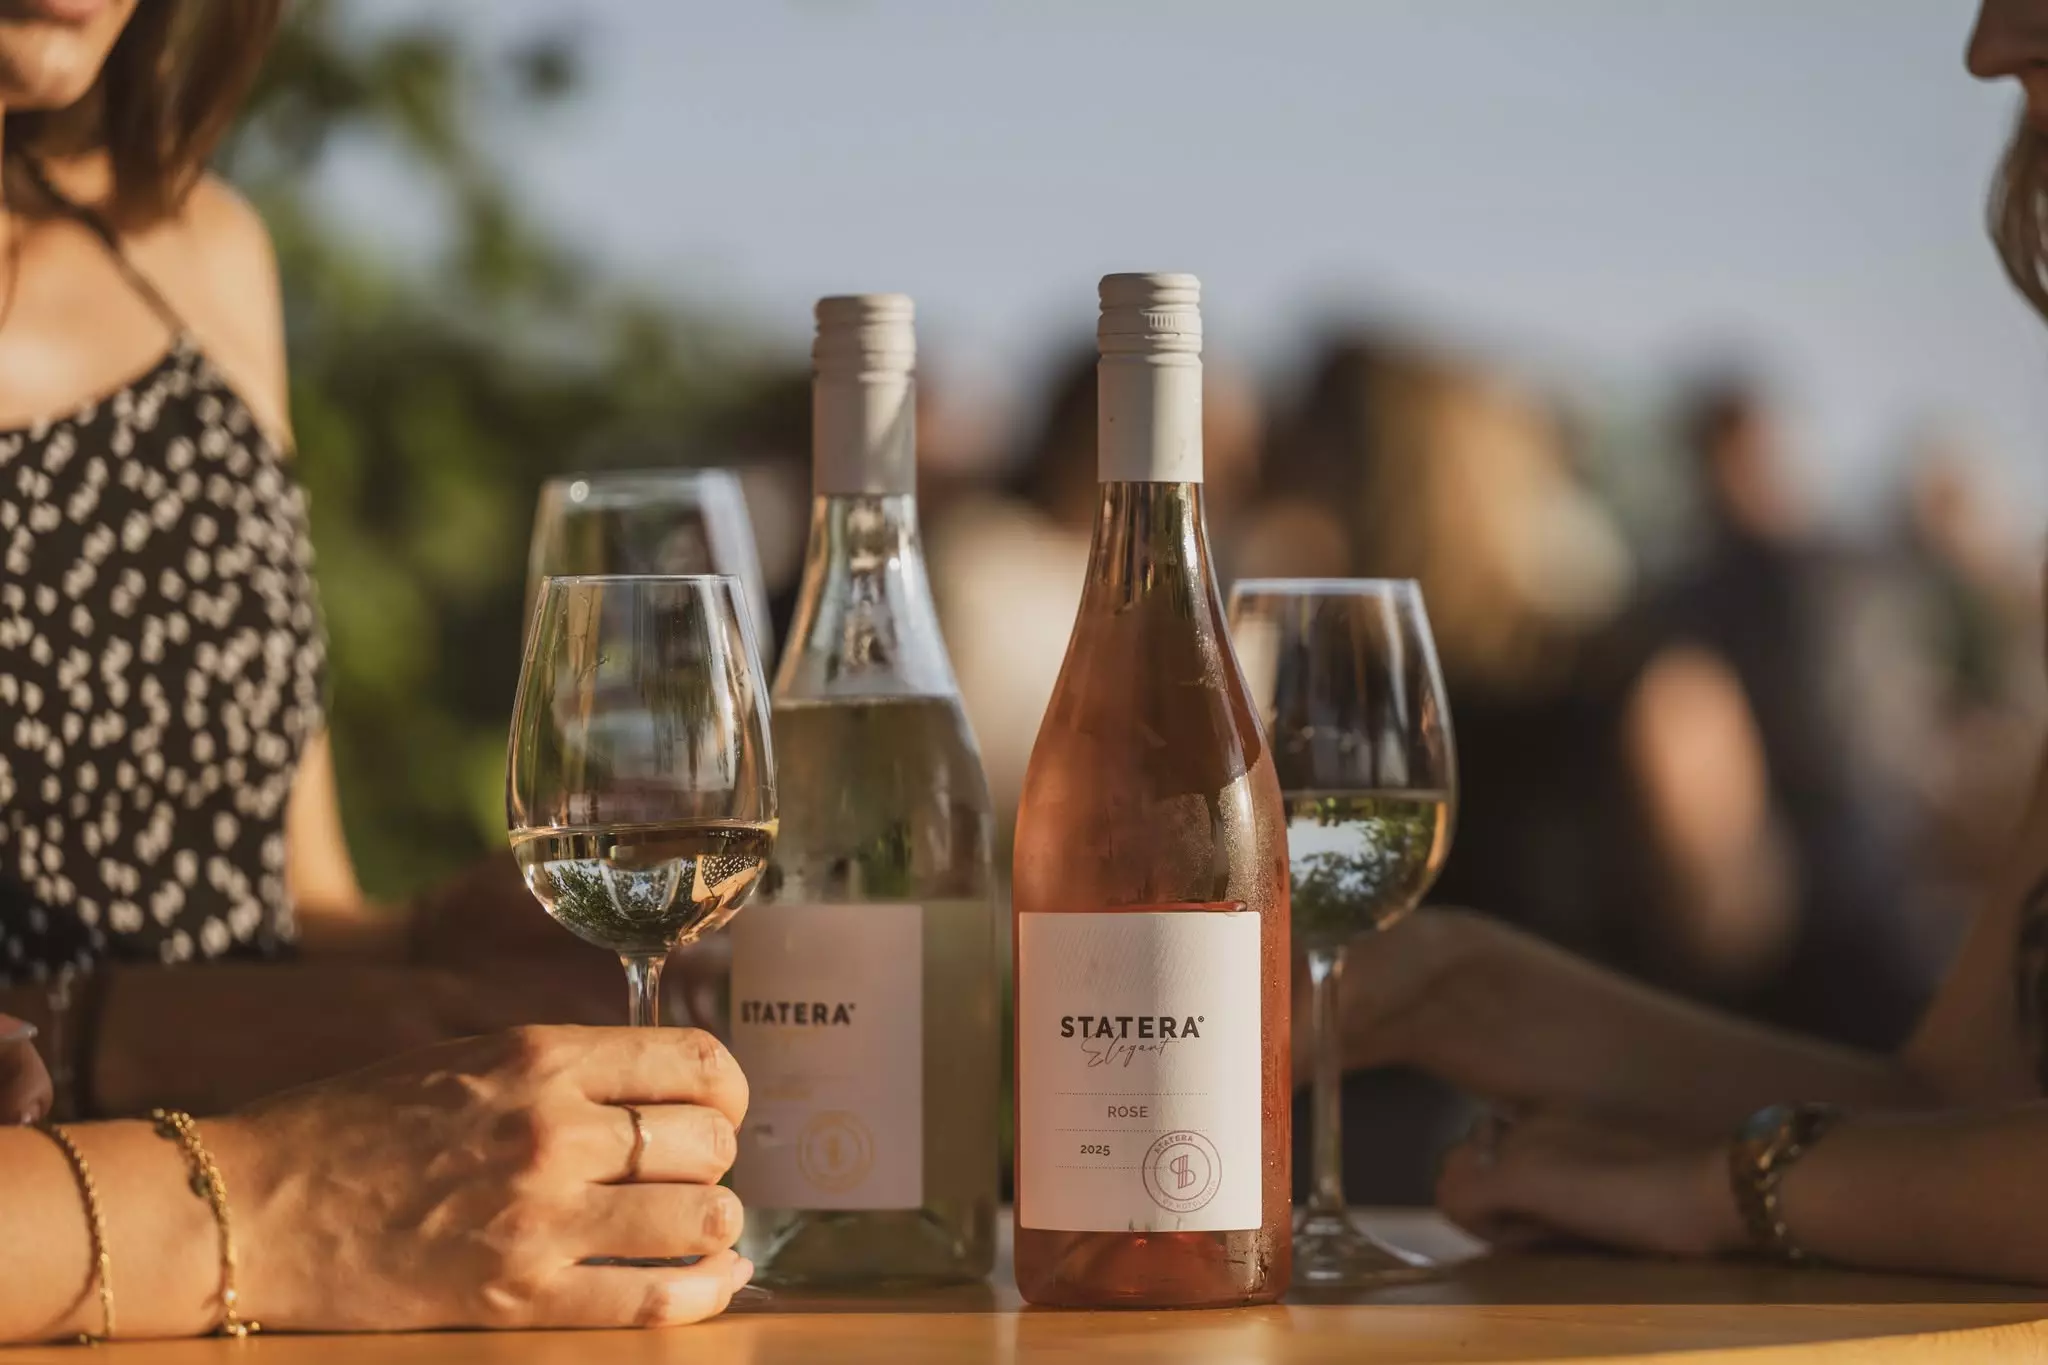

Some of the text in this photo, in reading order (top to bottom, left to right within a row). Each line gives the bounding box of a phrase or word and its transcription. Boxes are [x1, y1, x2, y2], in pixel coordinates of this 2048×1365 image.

[1081, 1030, 1180, 1068] Elegant
[1107, 1105, 1149, 1118] ROSE
[1080, 1144, 1111, 1156] 2025
